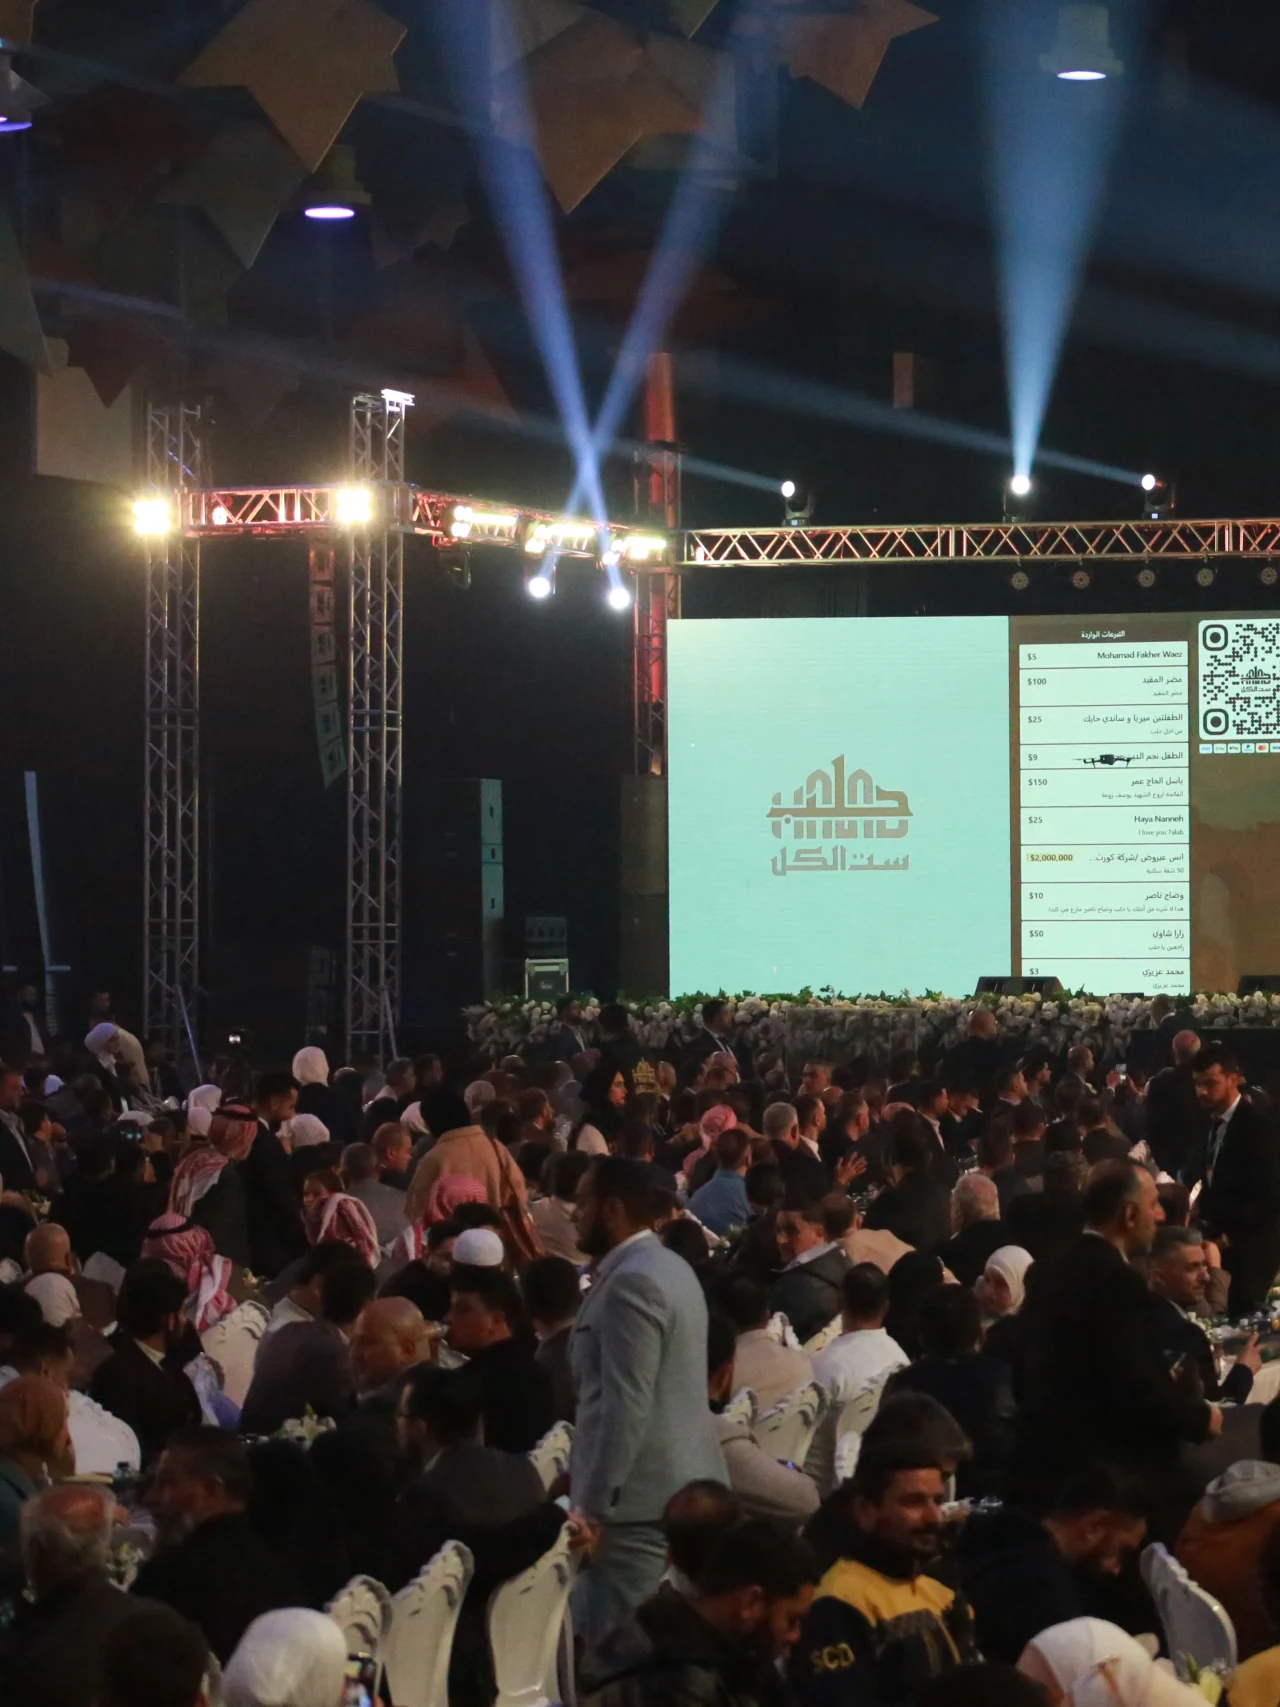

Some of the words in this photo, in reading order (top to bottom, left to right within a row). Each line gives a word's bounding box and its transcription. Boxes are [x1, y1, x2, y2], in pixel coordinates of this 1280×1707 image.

[1134, 816, 1153, 824] Haya
[770, 844, 847, 876] الكل
[848, 853, 909, 871] ست
[1030, 968, 1038, 976] $3
